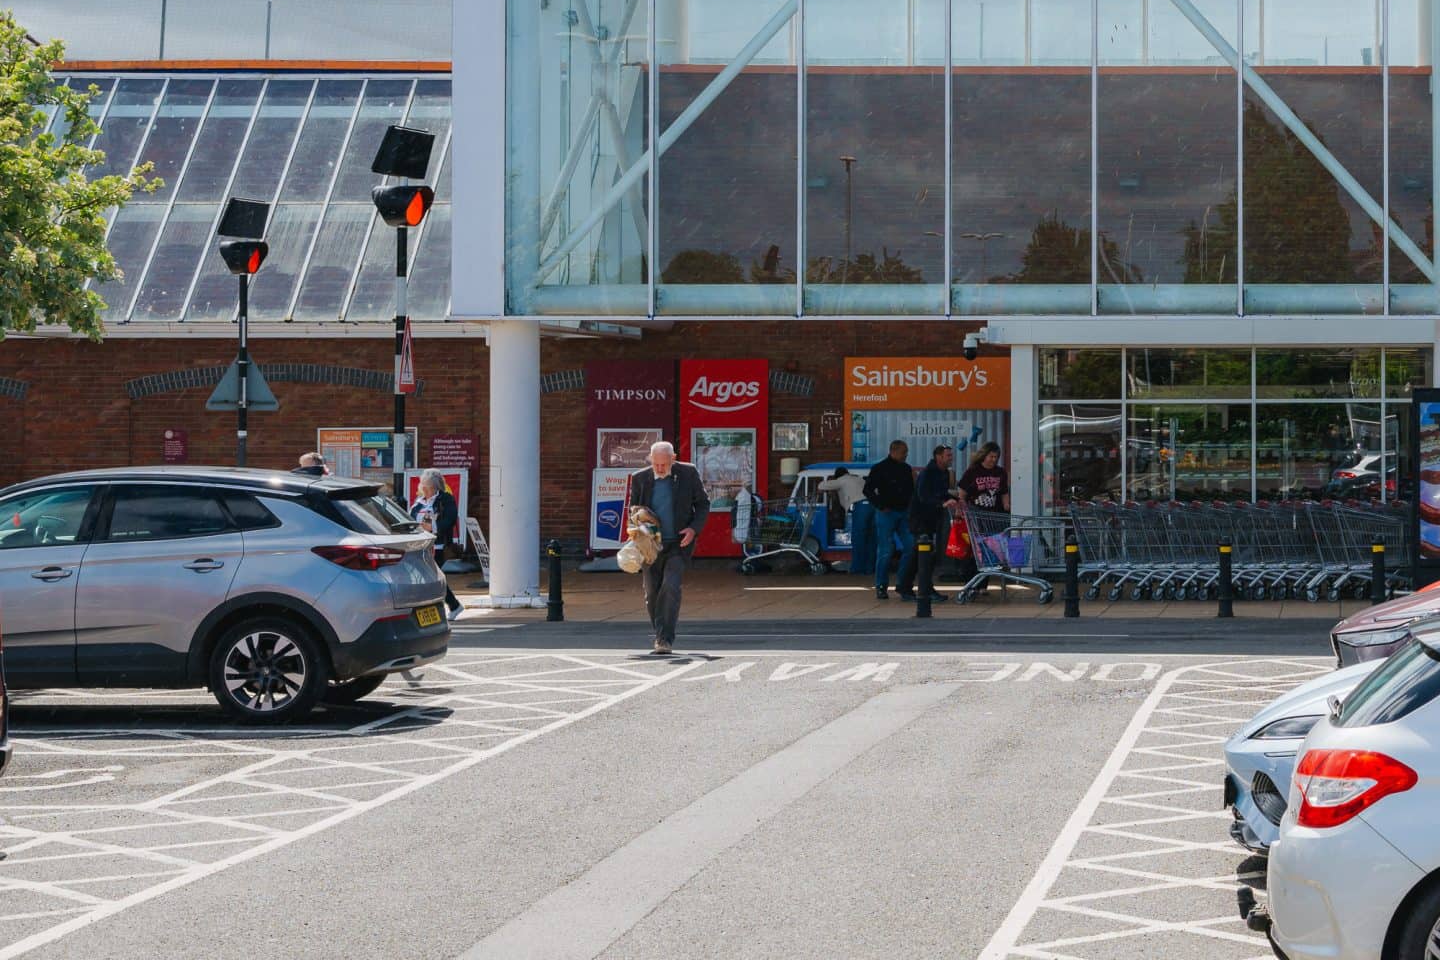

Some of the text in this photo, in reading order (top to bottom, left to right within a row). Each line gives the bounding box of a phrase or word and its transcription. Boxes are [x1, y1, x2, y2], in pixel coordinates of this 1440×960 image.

[852, 365, 988, 391] Sainsbury's
[594, 389, 667, 401] TIMPSON
[689, 376, 760, 403] Argos
[910, 423, 956, 436] habitat
[683, 661, 1162, 683] ONE WAY
